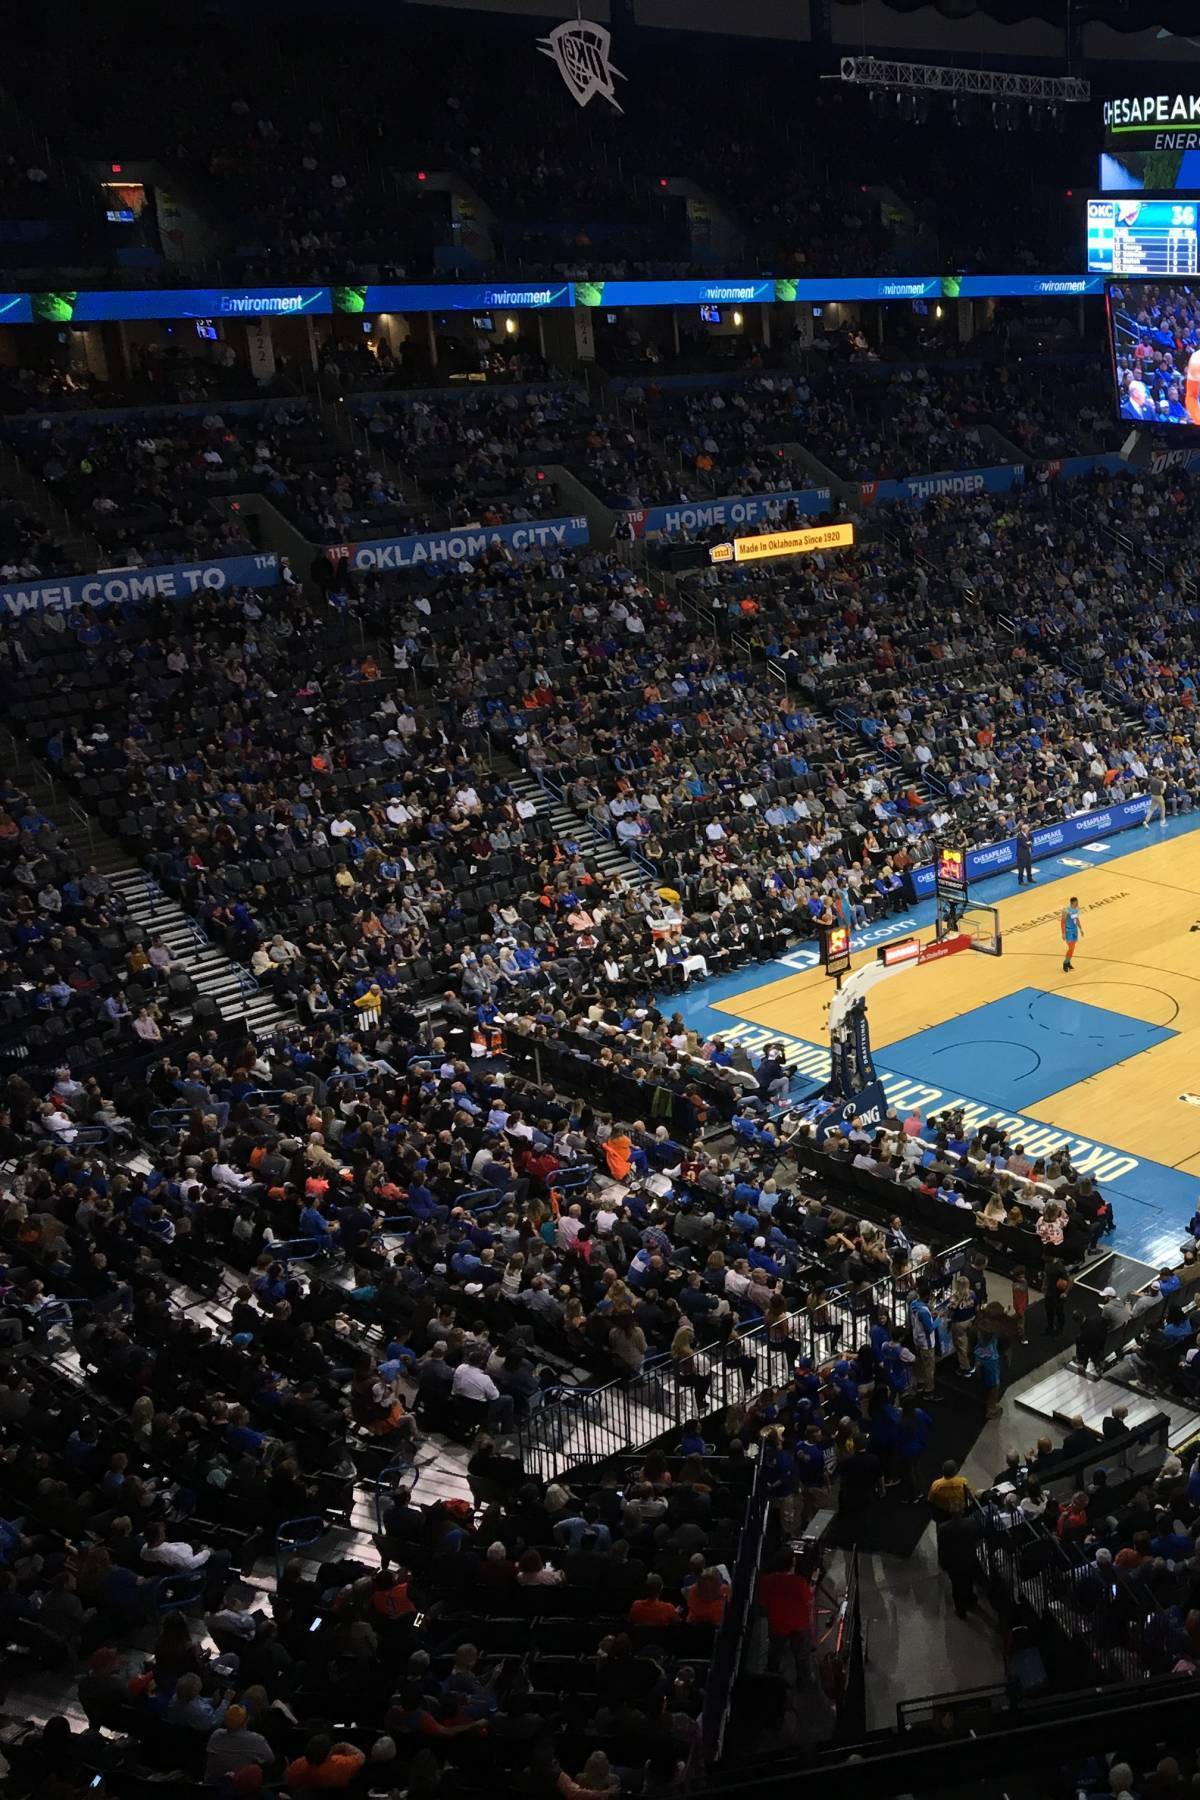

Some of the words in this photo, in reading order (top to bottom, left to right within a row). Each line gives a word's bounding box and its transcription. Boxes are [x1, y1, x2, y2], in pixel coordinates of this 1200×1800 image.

[1089, 204, 1114, 217] OKC
[1171, 206, 1195, 226] 36
[817, 488, 831, 500] 116
[861, 484, 875, 495] 117
[908, 474, 984, 498] THUNDER
[570, 518, 588, 529] 115
[627, 511, 644, 523] 116
[665, 505, 726, 532] HOME
[730, 503, 758, 523] OF
[511, 525, 566, 550] CITY
[739, 544, 759, 555] Made
[768, 538, 803, 551] Oklahoma
[804, 536, 823, 546] Since
[824, 532, 841, 544] 1920
[328, 546, 349, 560] 115
[254, 555, 277, 569] 114
[3, 573, 177, 617] WELCOME
[182, 567, 226, 592] TO
[1076, 813, 1111, 830] CHESAPEAKE
[1034, 829, 1062, 844] ESAPEAKE
[973, 846, 1012, 864] CHESAPEAKE
[1088, 891, 1131, 911] ARENA
[859, 1018, 869, 1065] DRAFTKINGS
